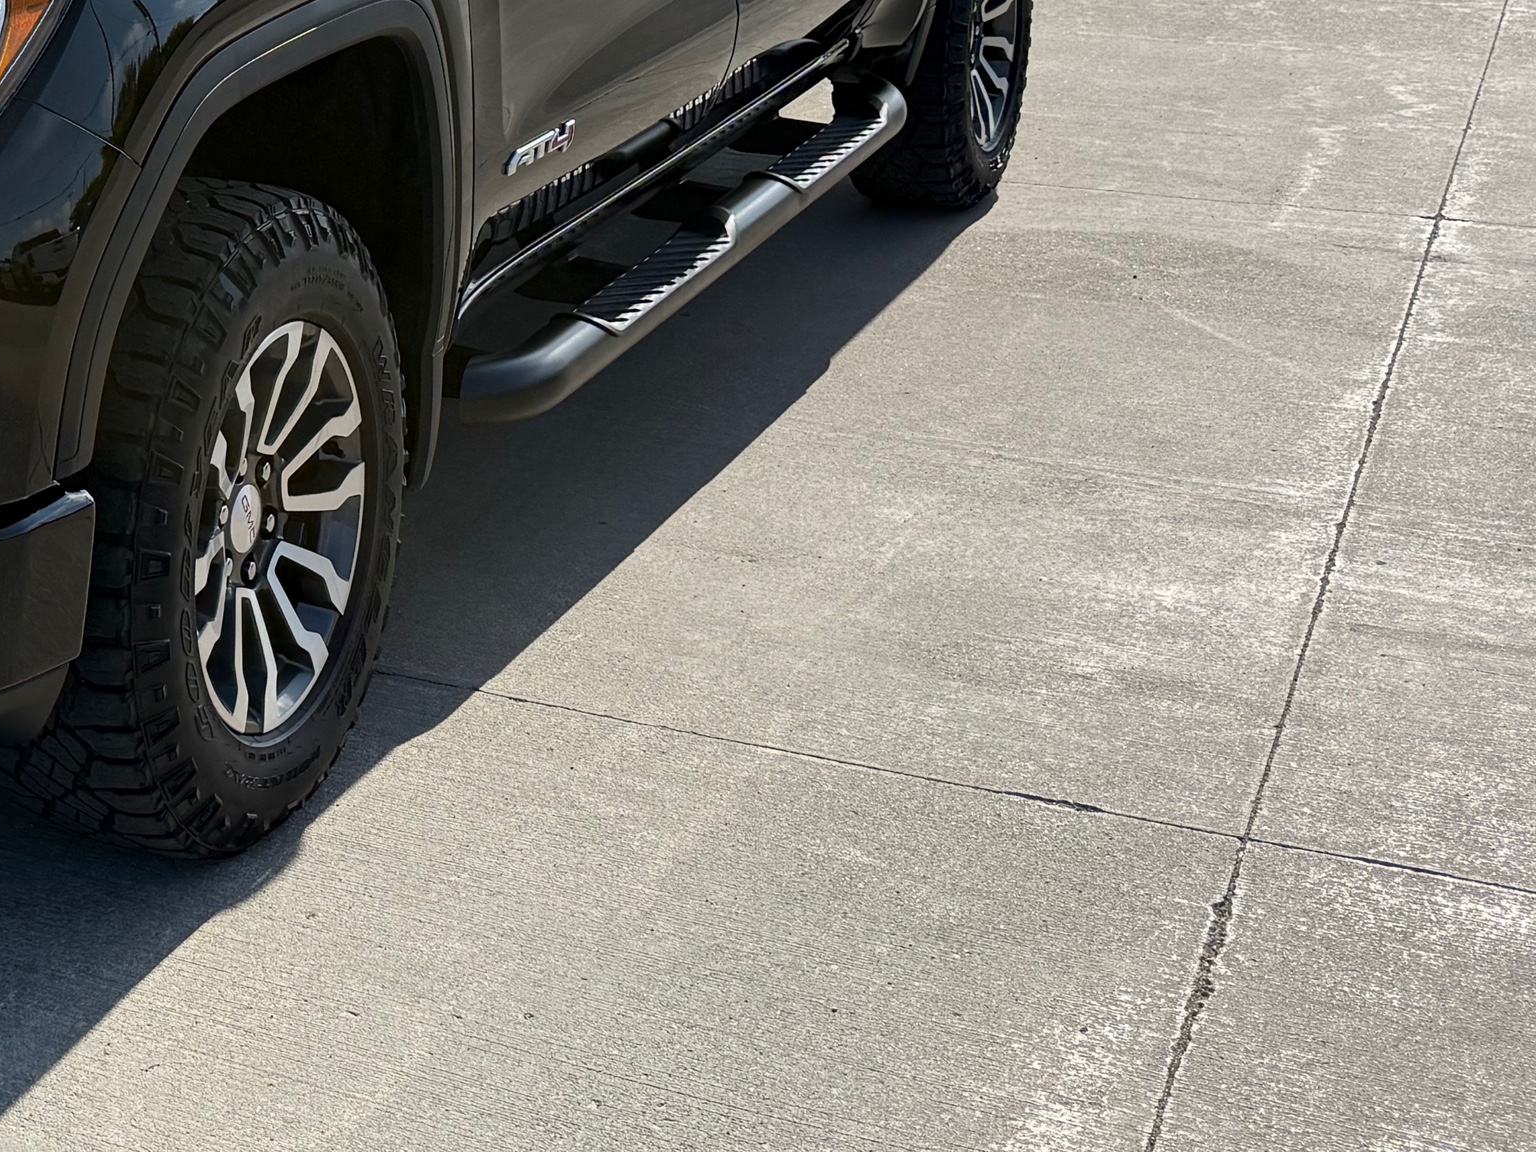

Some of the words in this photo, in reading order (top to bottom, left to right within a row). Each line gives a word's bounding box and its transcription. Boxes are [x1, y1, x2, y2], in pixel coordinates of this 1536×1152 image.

[505, 119, 576, 177] AT4
[241, 494, 255, 544] GMC
[336, 335, 399, 719] WRANGLER
